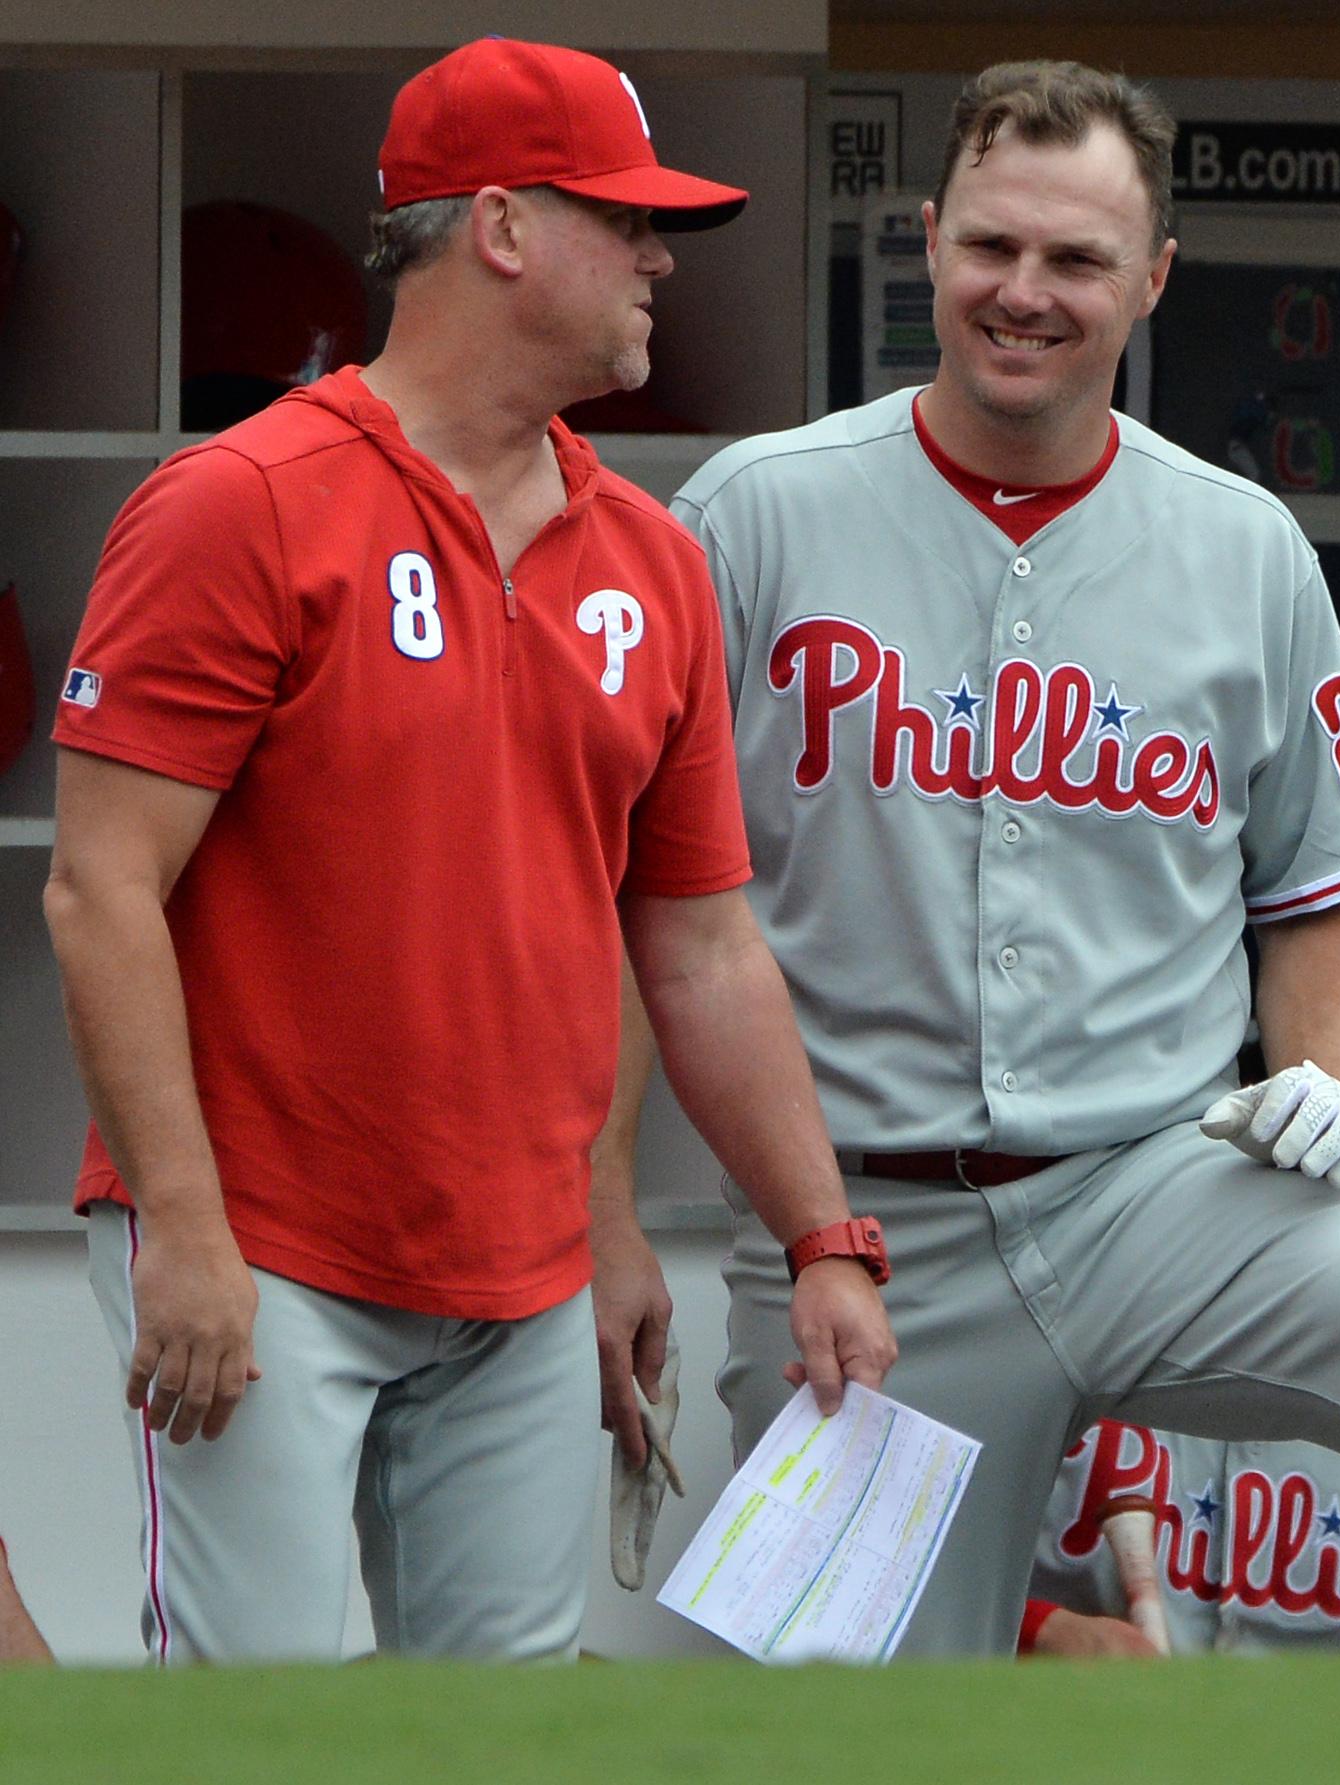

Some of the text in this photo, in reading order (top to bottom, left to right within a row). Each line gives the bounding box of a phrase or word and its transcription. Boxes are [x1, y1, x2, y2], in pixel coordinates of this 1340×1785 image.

[832, 121, 885, 158] EW
[832, 160, 885, 196] RA
[388, 550, 445, 662] 8
[576, 589, 644, 695] P
[768, 614, 1221, 833] Phillies
